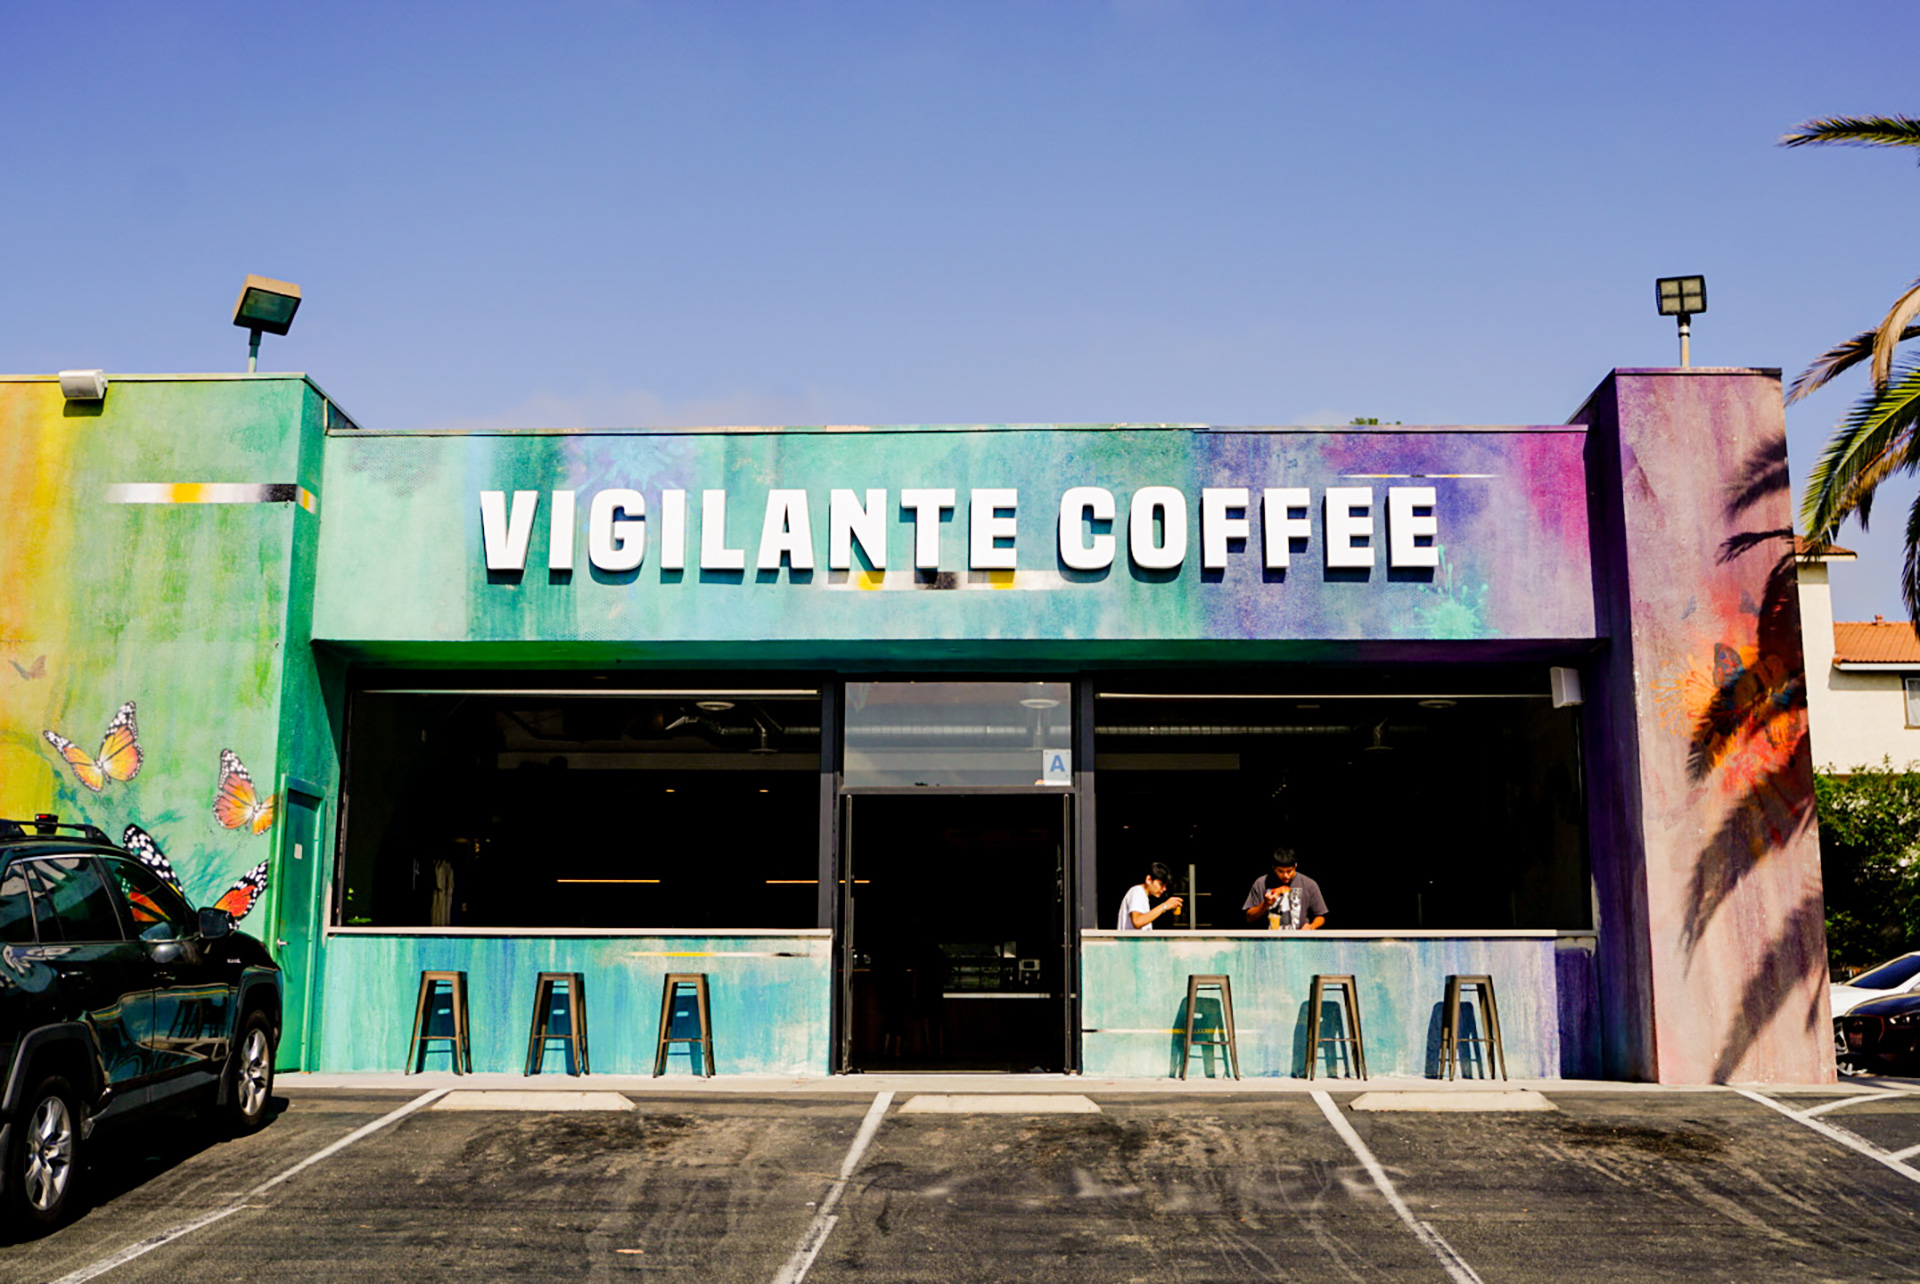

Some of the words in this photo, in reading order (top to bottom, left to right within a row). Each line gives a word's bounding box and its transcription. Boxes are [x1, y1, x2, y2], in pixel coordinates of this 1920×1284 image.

[480, 488, 1017, 569] VIGILANTE
[1059, 486, 1439, 569] COFFEE
[1050, 755, 1065, 772] A
